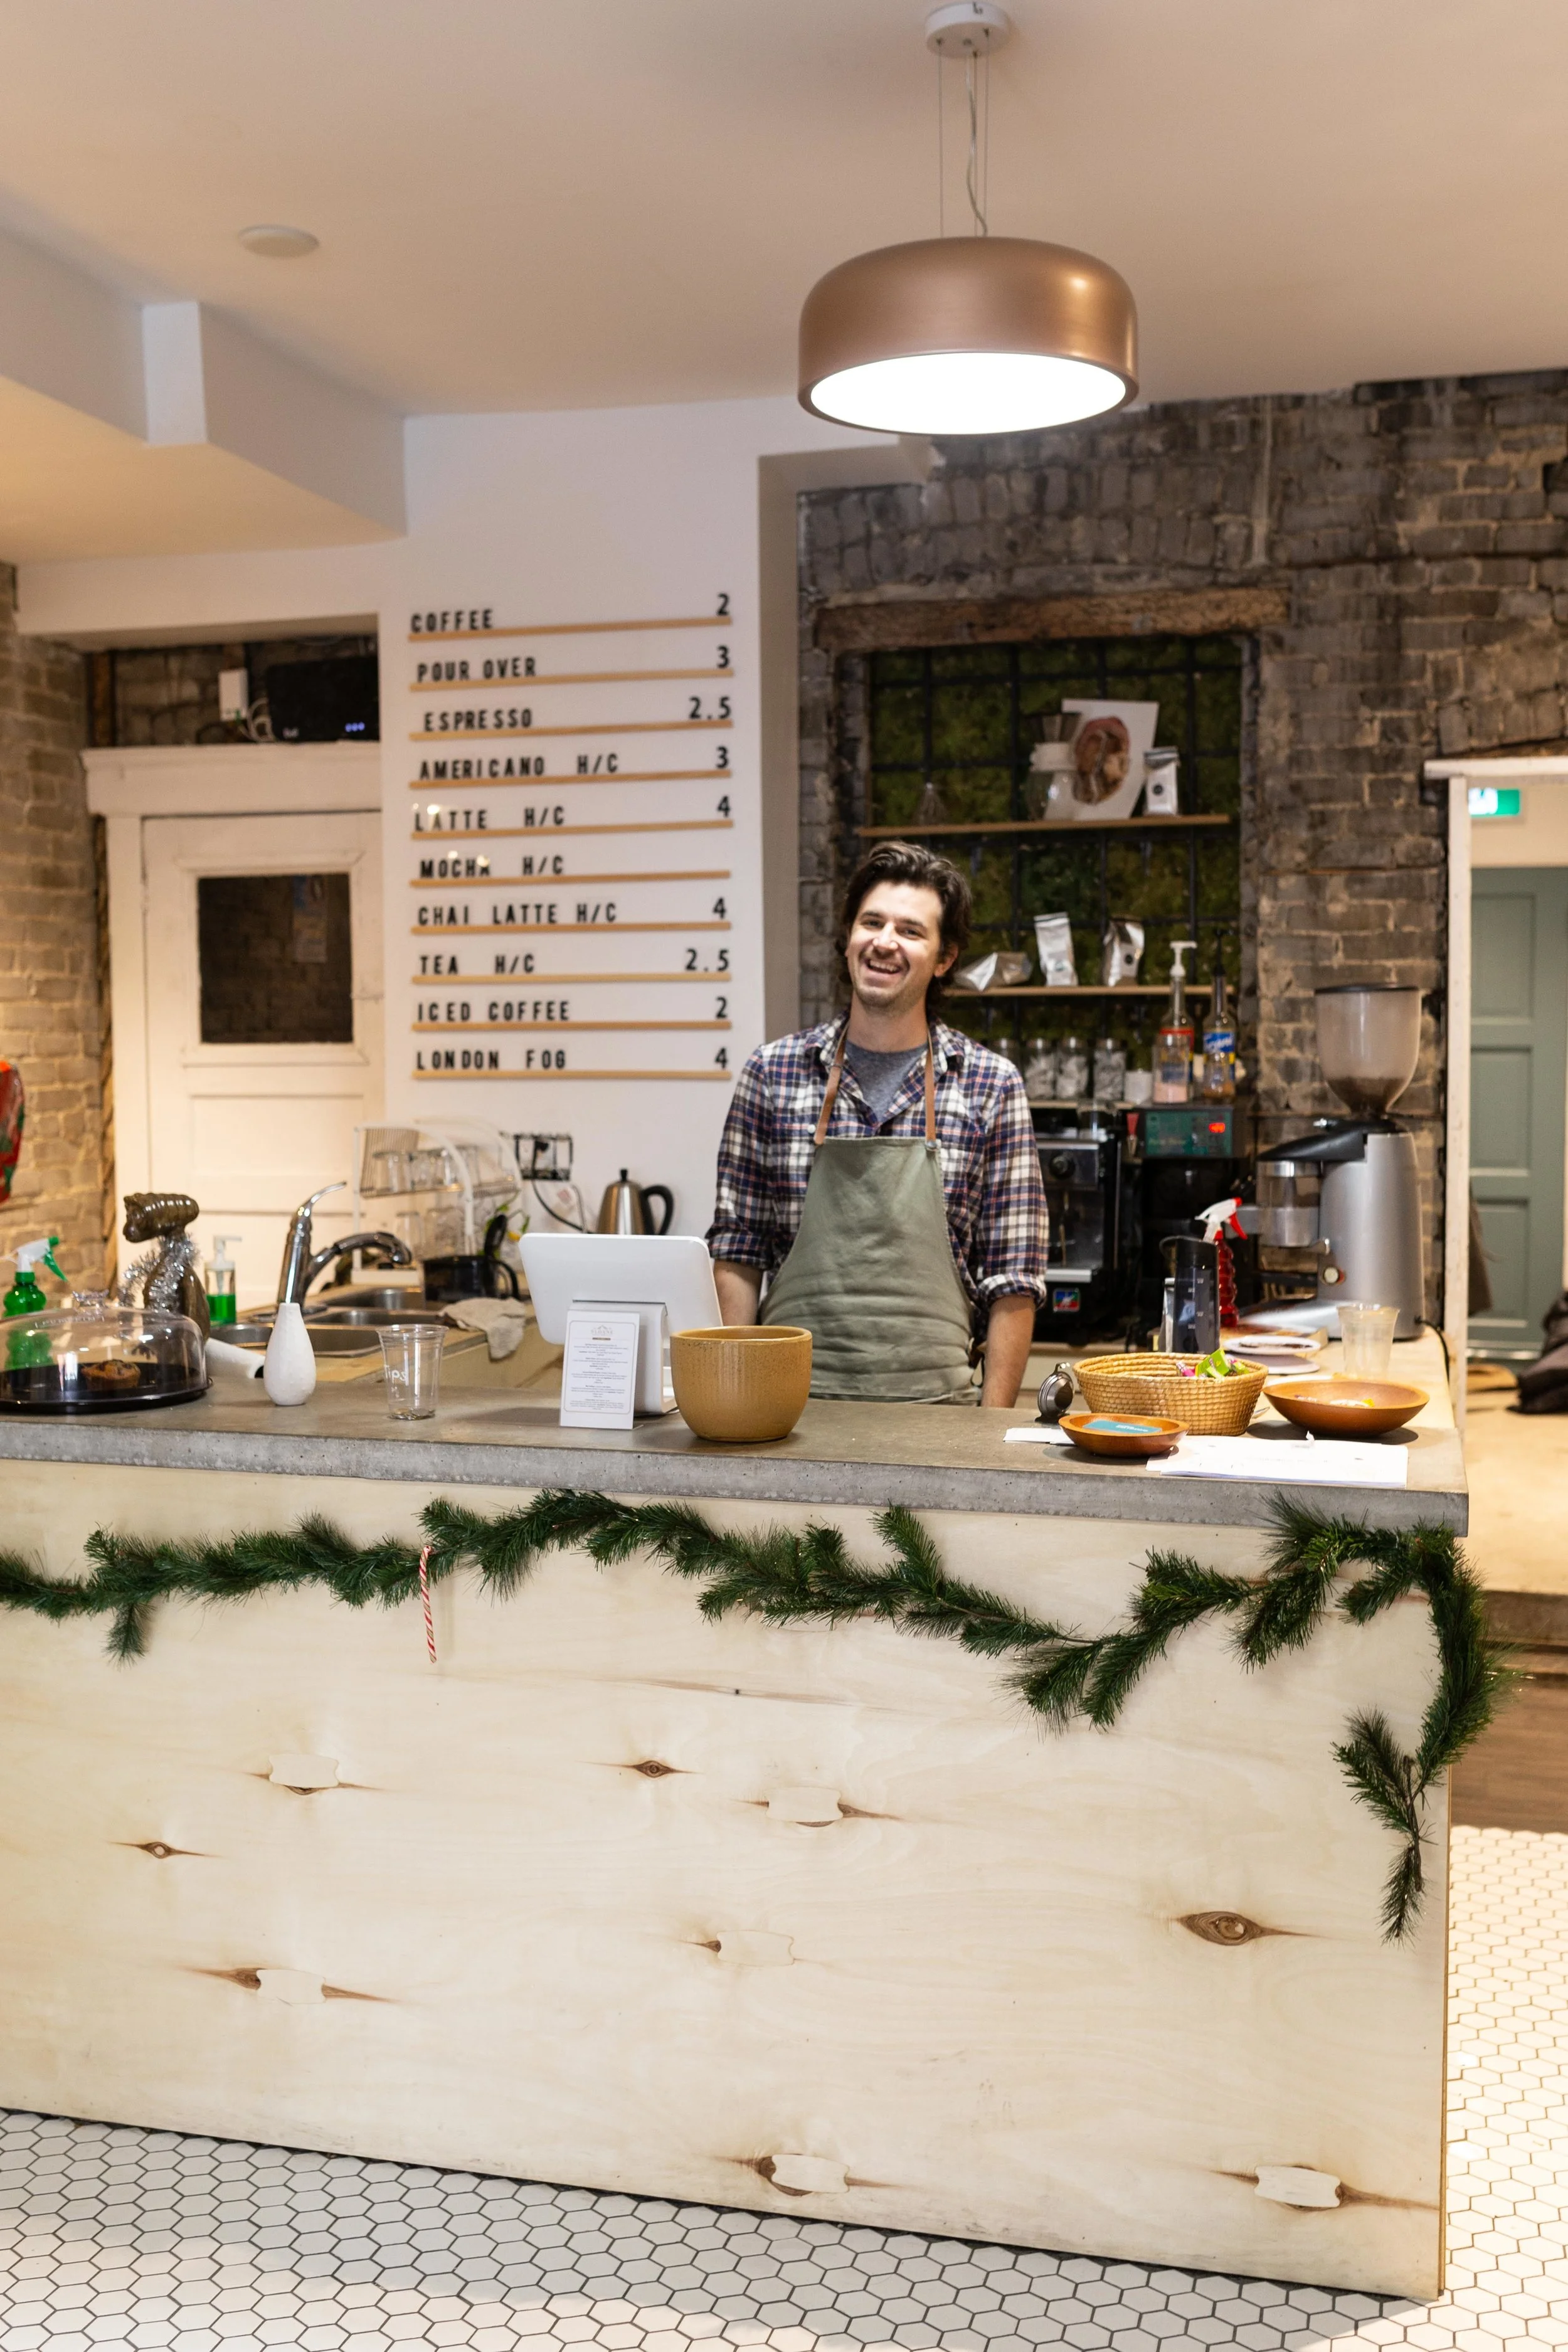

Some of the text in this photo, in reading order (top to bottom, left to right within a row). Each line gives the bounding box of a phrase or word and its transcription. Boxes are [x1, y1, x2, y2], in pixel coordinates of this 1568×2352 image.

[410, 592, 730, 633] COFFEE 2
[416, 645, 730, 683] POUR OVER 3
[423, 696, 732, 733] ESPRESSO 2.5
[419, 745, 729, 780] AMERICANO H/C 3
[415, 795, 731, 831] LATTE H/C 4
[522, 855, 563, 877] H/C
[418, 897, 727, 926] CHAI LATTE H/C 4
[419, 948, 729, 975] TEA H/C 2.5
[417, 996, 728, 1022] ICED COFFEE 2
[416, 1046, 729, 1071] LONDON FOG 4
